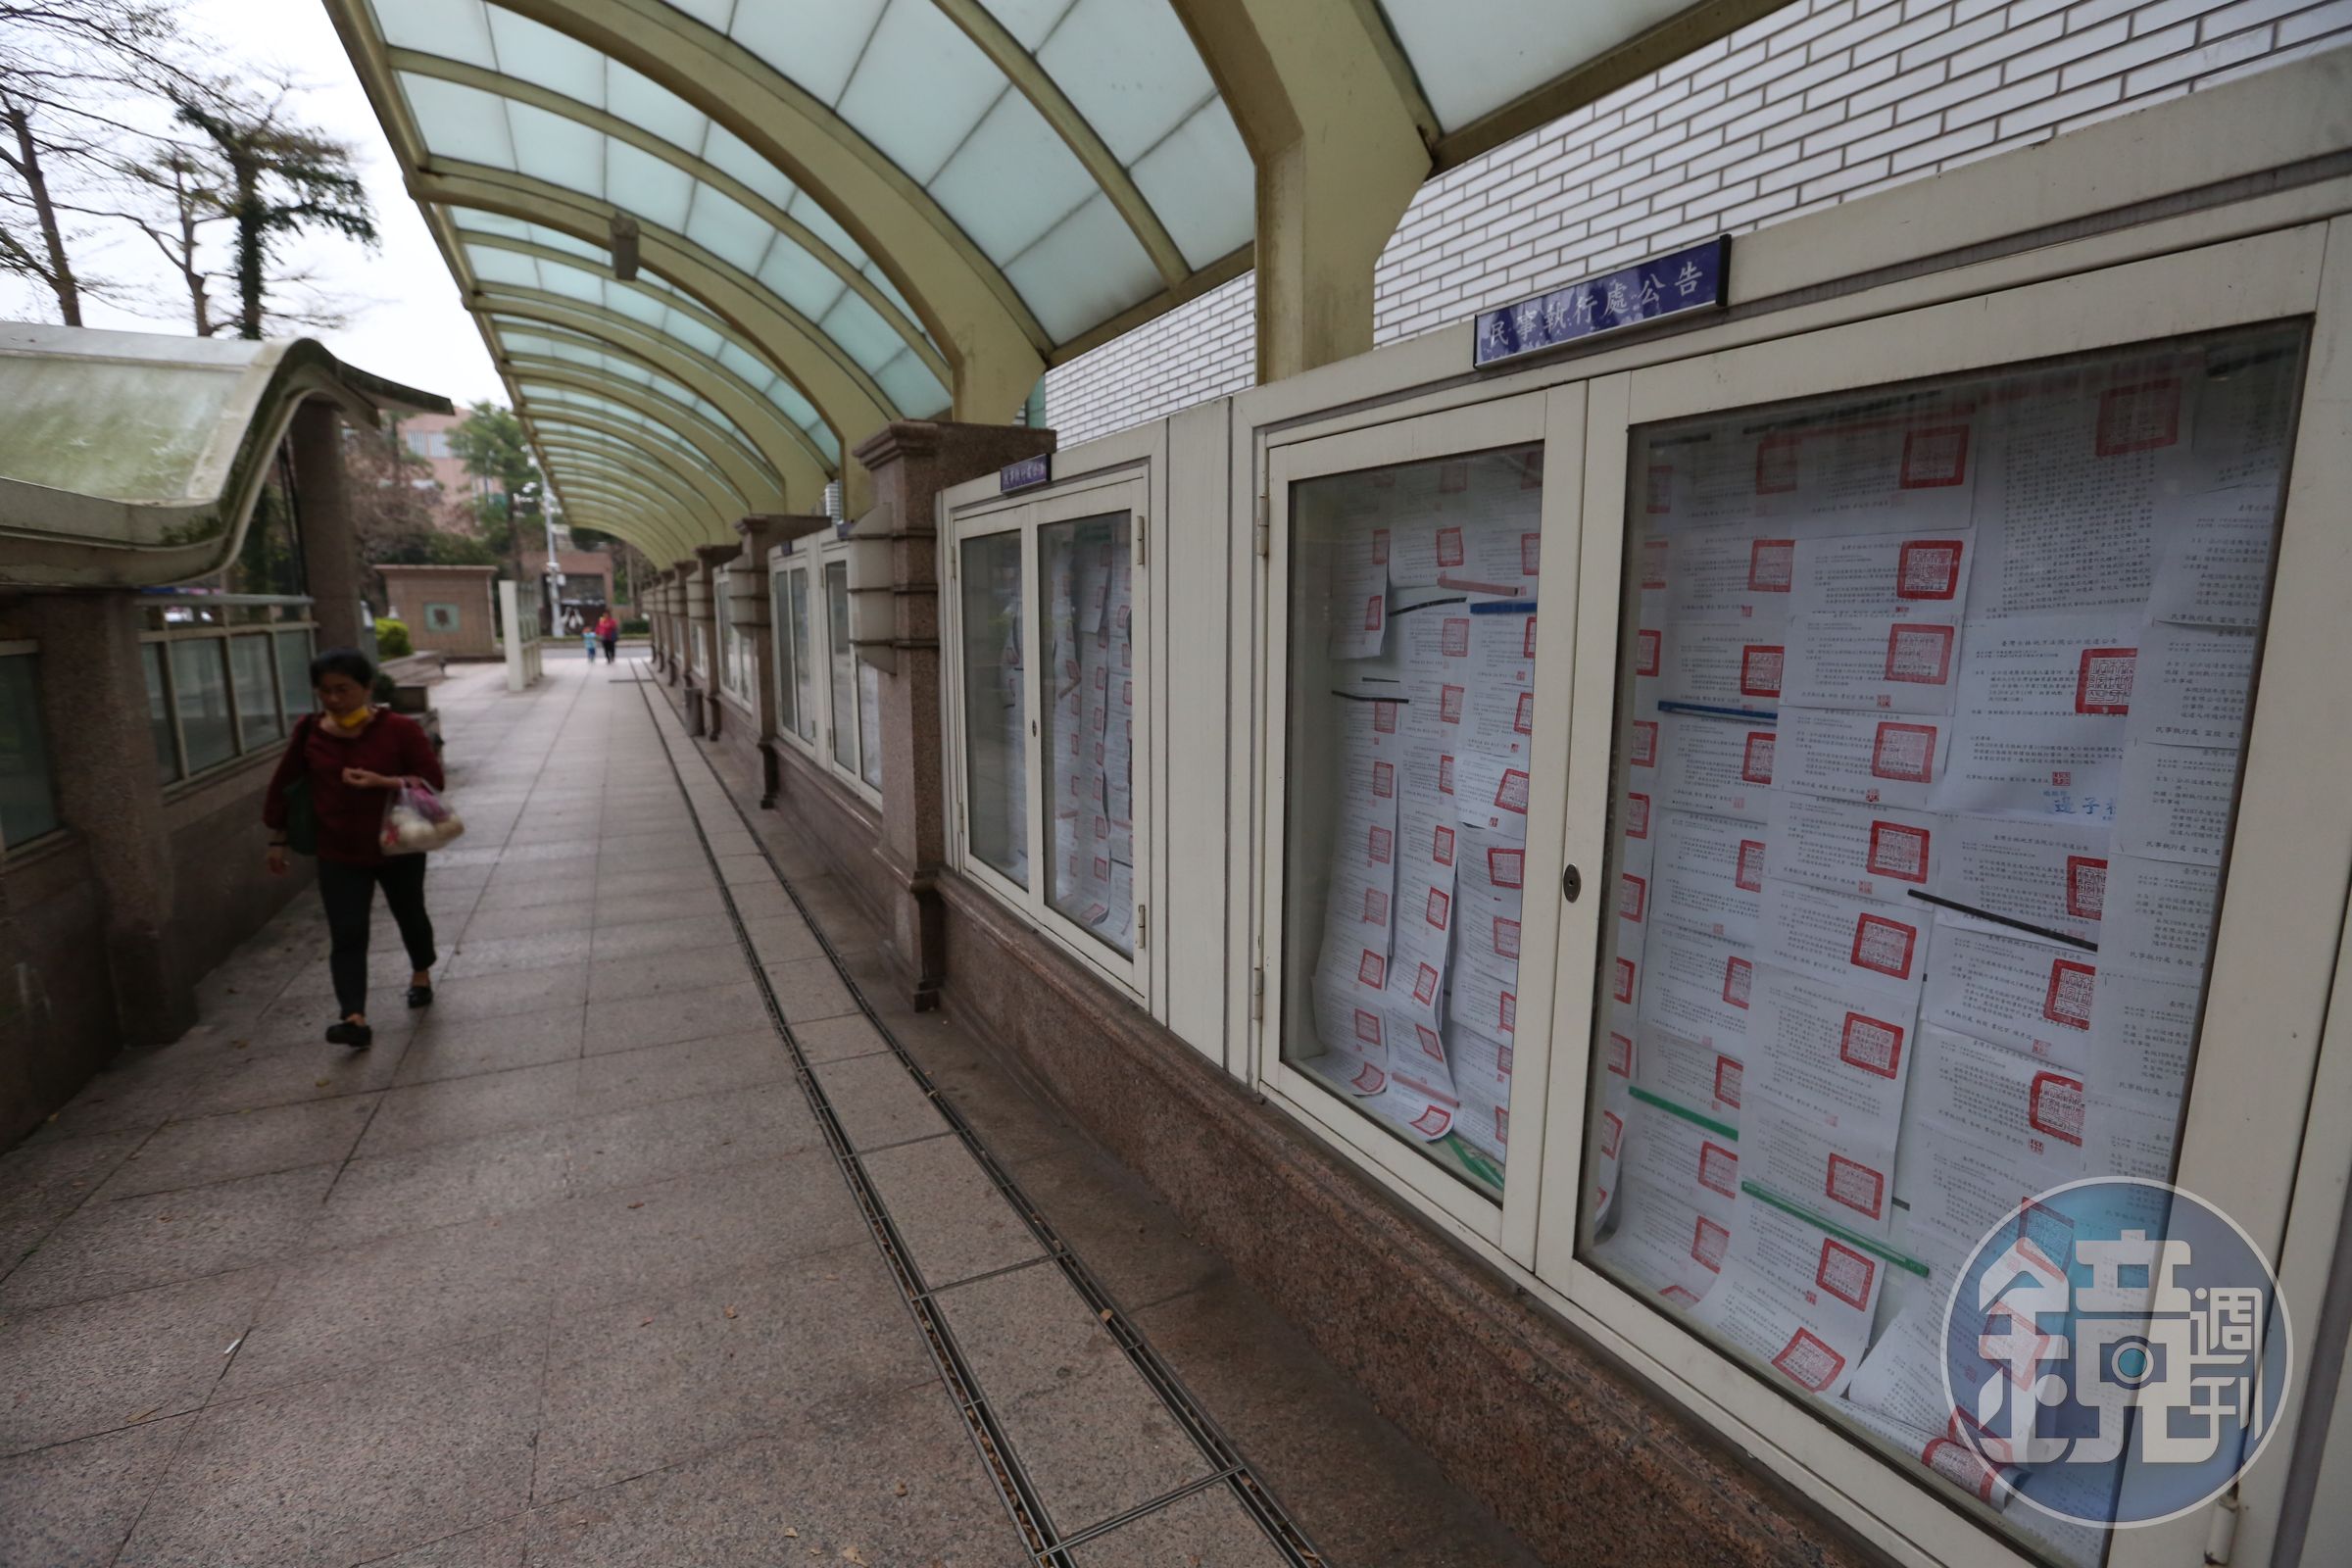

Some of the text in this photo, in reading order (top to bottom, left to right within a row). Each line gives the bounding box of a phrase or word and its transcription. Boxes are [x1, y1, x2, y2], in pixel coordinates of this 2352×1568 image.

[1490, 261, 1703, 346] 民事執行處公告
